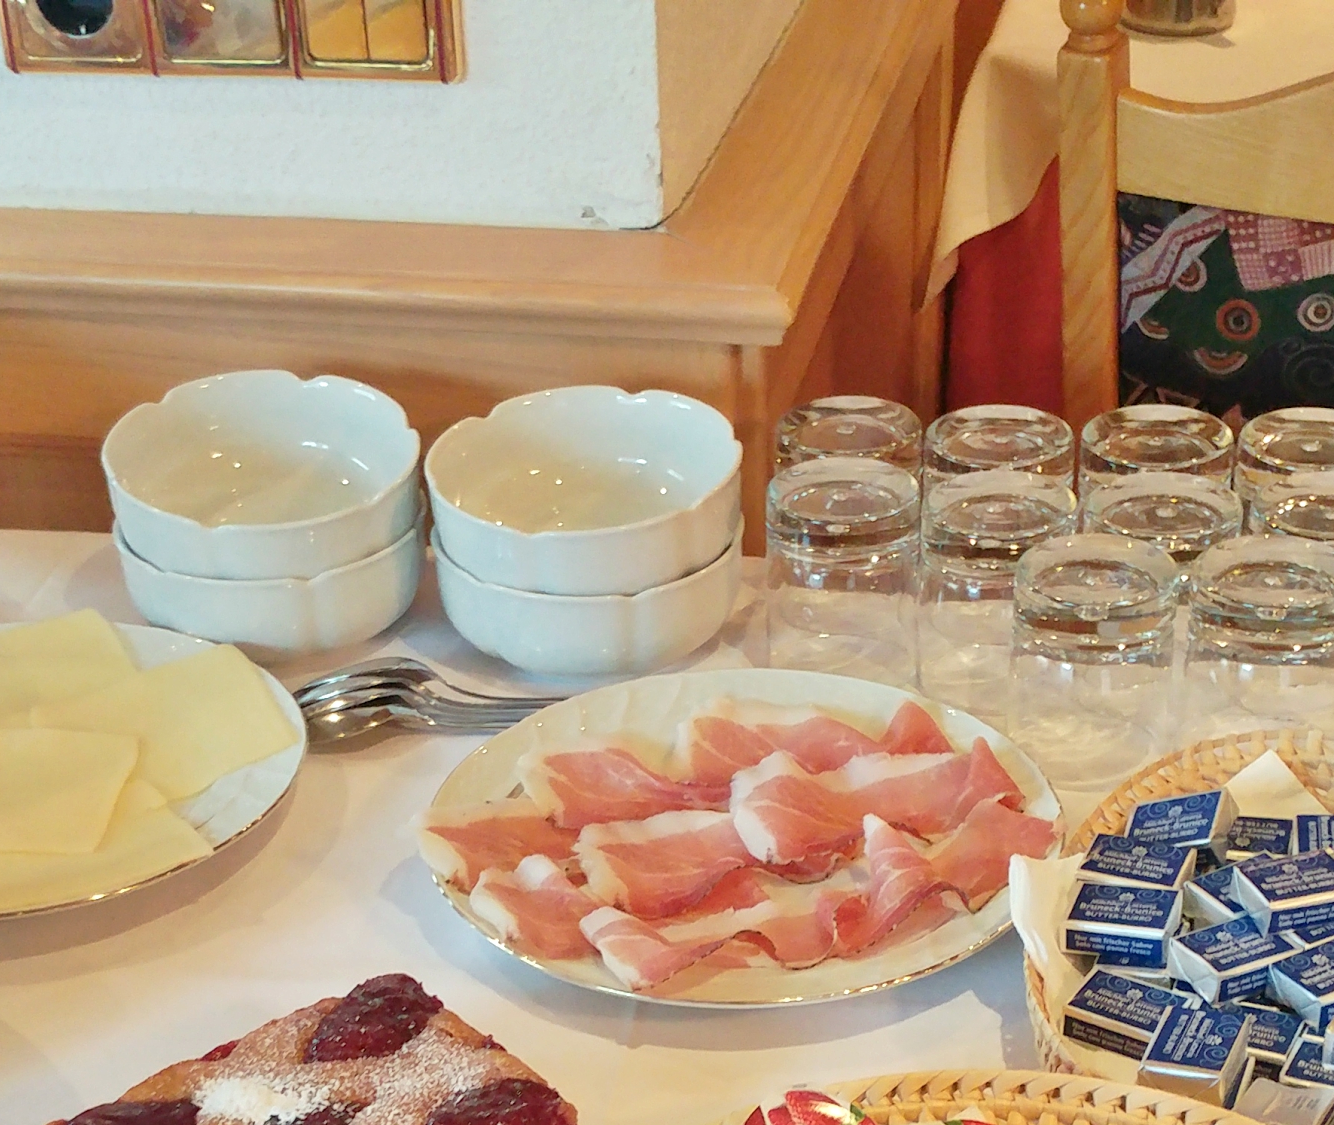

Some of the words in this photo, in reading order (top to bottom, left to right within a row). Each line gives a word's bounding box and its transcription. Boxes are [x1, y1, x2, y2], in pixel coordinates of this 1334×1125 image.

[1133, 818, 1209, 837] Bruneck-Brunico
[1092, 851, 1175, 876] Bruneck-Brunico
[1097, 862, 1163, 880] BUTTER-BURRO
[1079, 901, 1164, 917] Bruneck-Brunico
[1085, 911, 1153, 923] BUTTER-BURRO
[1086, 1000, 1152, 1026] BUTTER-BURRO
